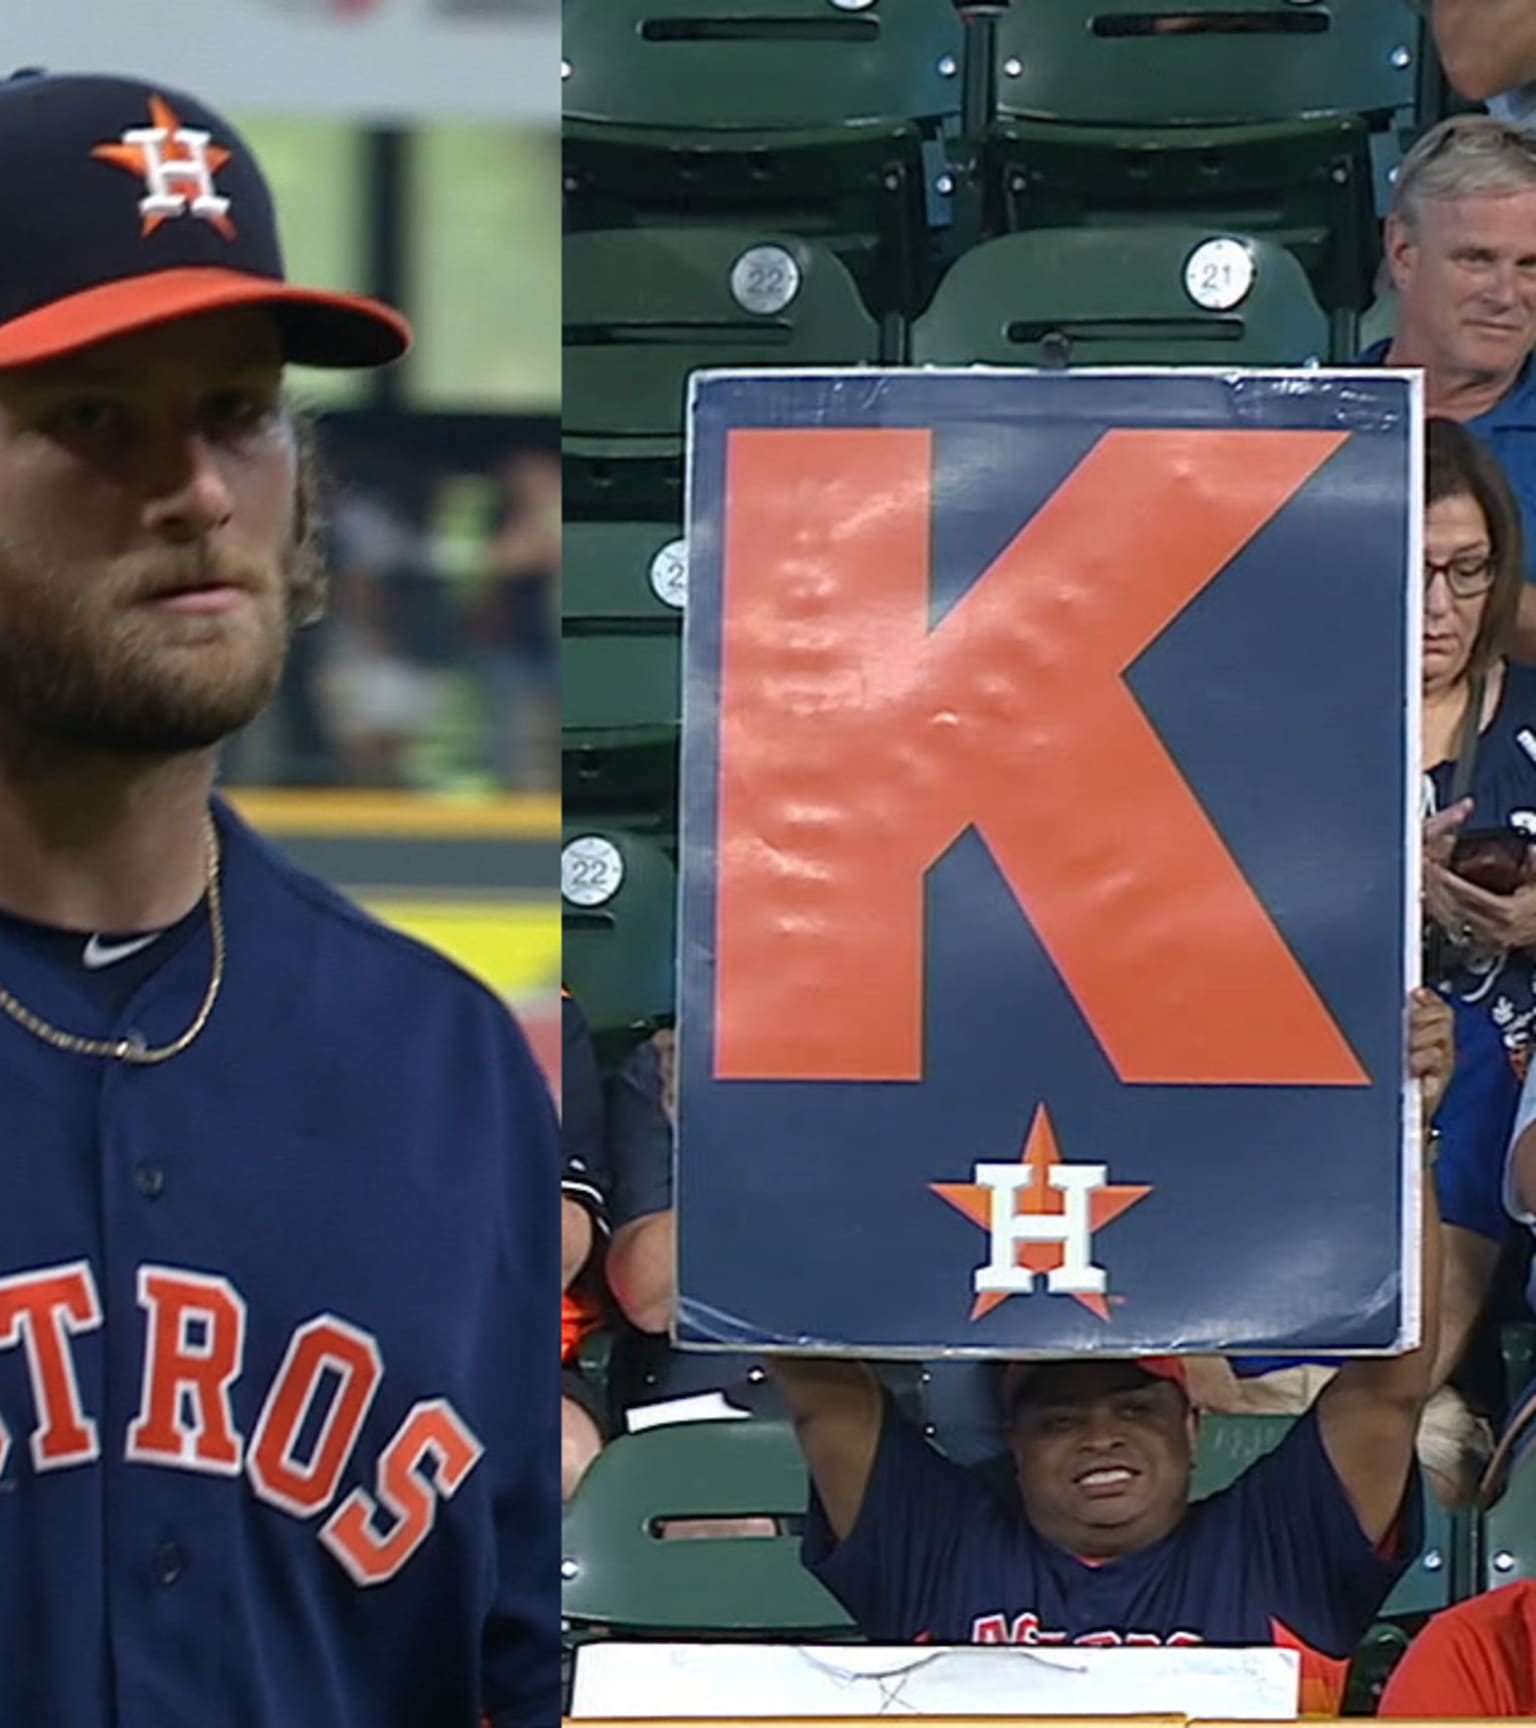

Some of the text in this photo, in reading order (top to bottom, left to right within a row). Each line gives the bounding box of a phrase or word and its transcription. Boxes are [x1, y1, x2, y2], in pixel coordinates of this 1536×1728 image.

[121, 126, 231, 218] H
[747, 266, 783, 294] 22
[1202, 263, 1232, 289] 21
[667, 562, 686, 589] 2
[713, 428, 1372, 1086] K
[571, 860, 608, 885] 22
[974, 1162, 1109, 1294] H
